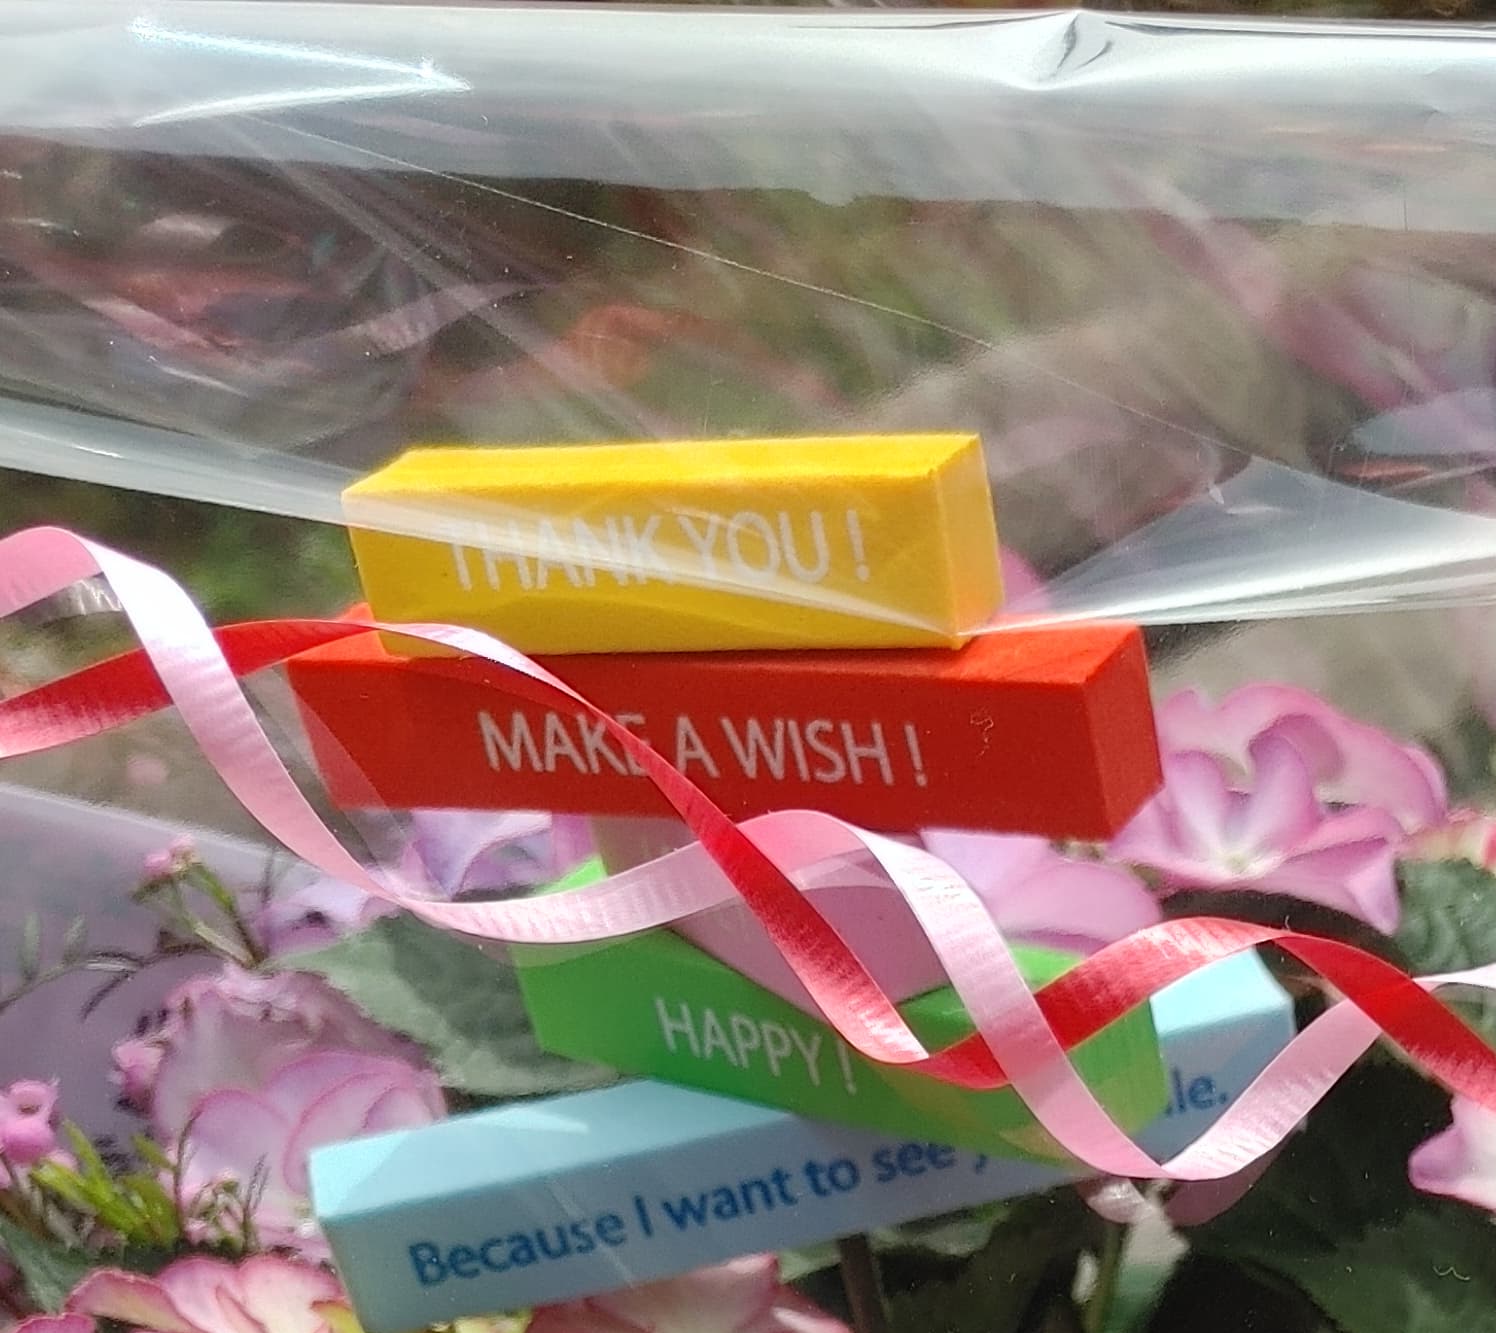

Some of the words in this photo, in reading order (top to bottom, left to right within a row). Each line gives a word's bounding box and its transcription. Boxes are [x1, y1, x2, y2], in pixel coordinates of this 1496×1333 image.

[479, 710, 650, 777] MAKE
[674, 717, 721, 779] A
[409, 1213, 626, 1287] Because
[634, 1195, 653, 1237] I
[663, 1166, 797, 1232] want
[805, 1155, 861, 1197] to
